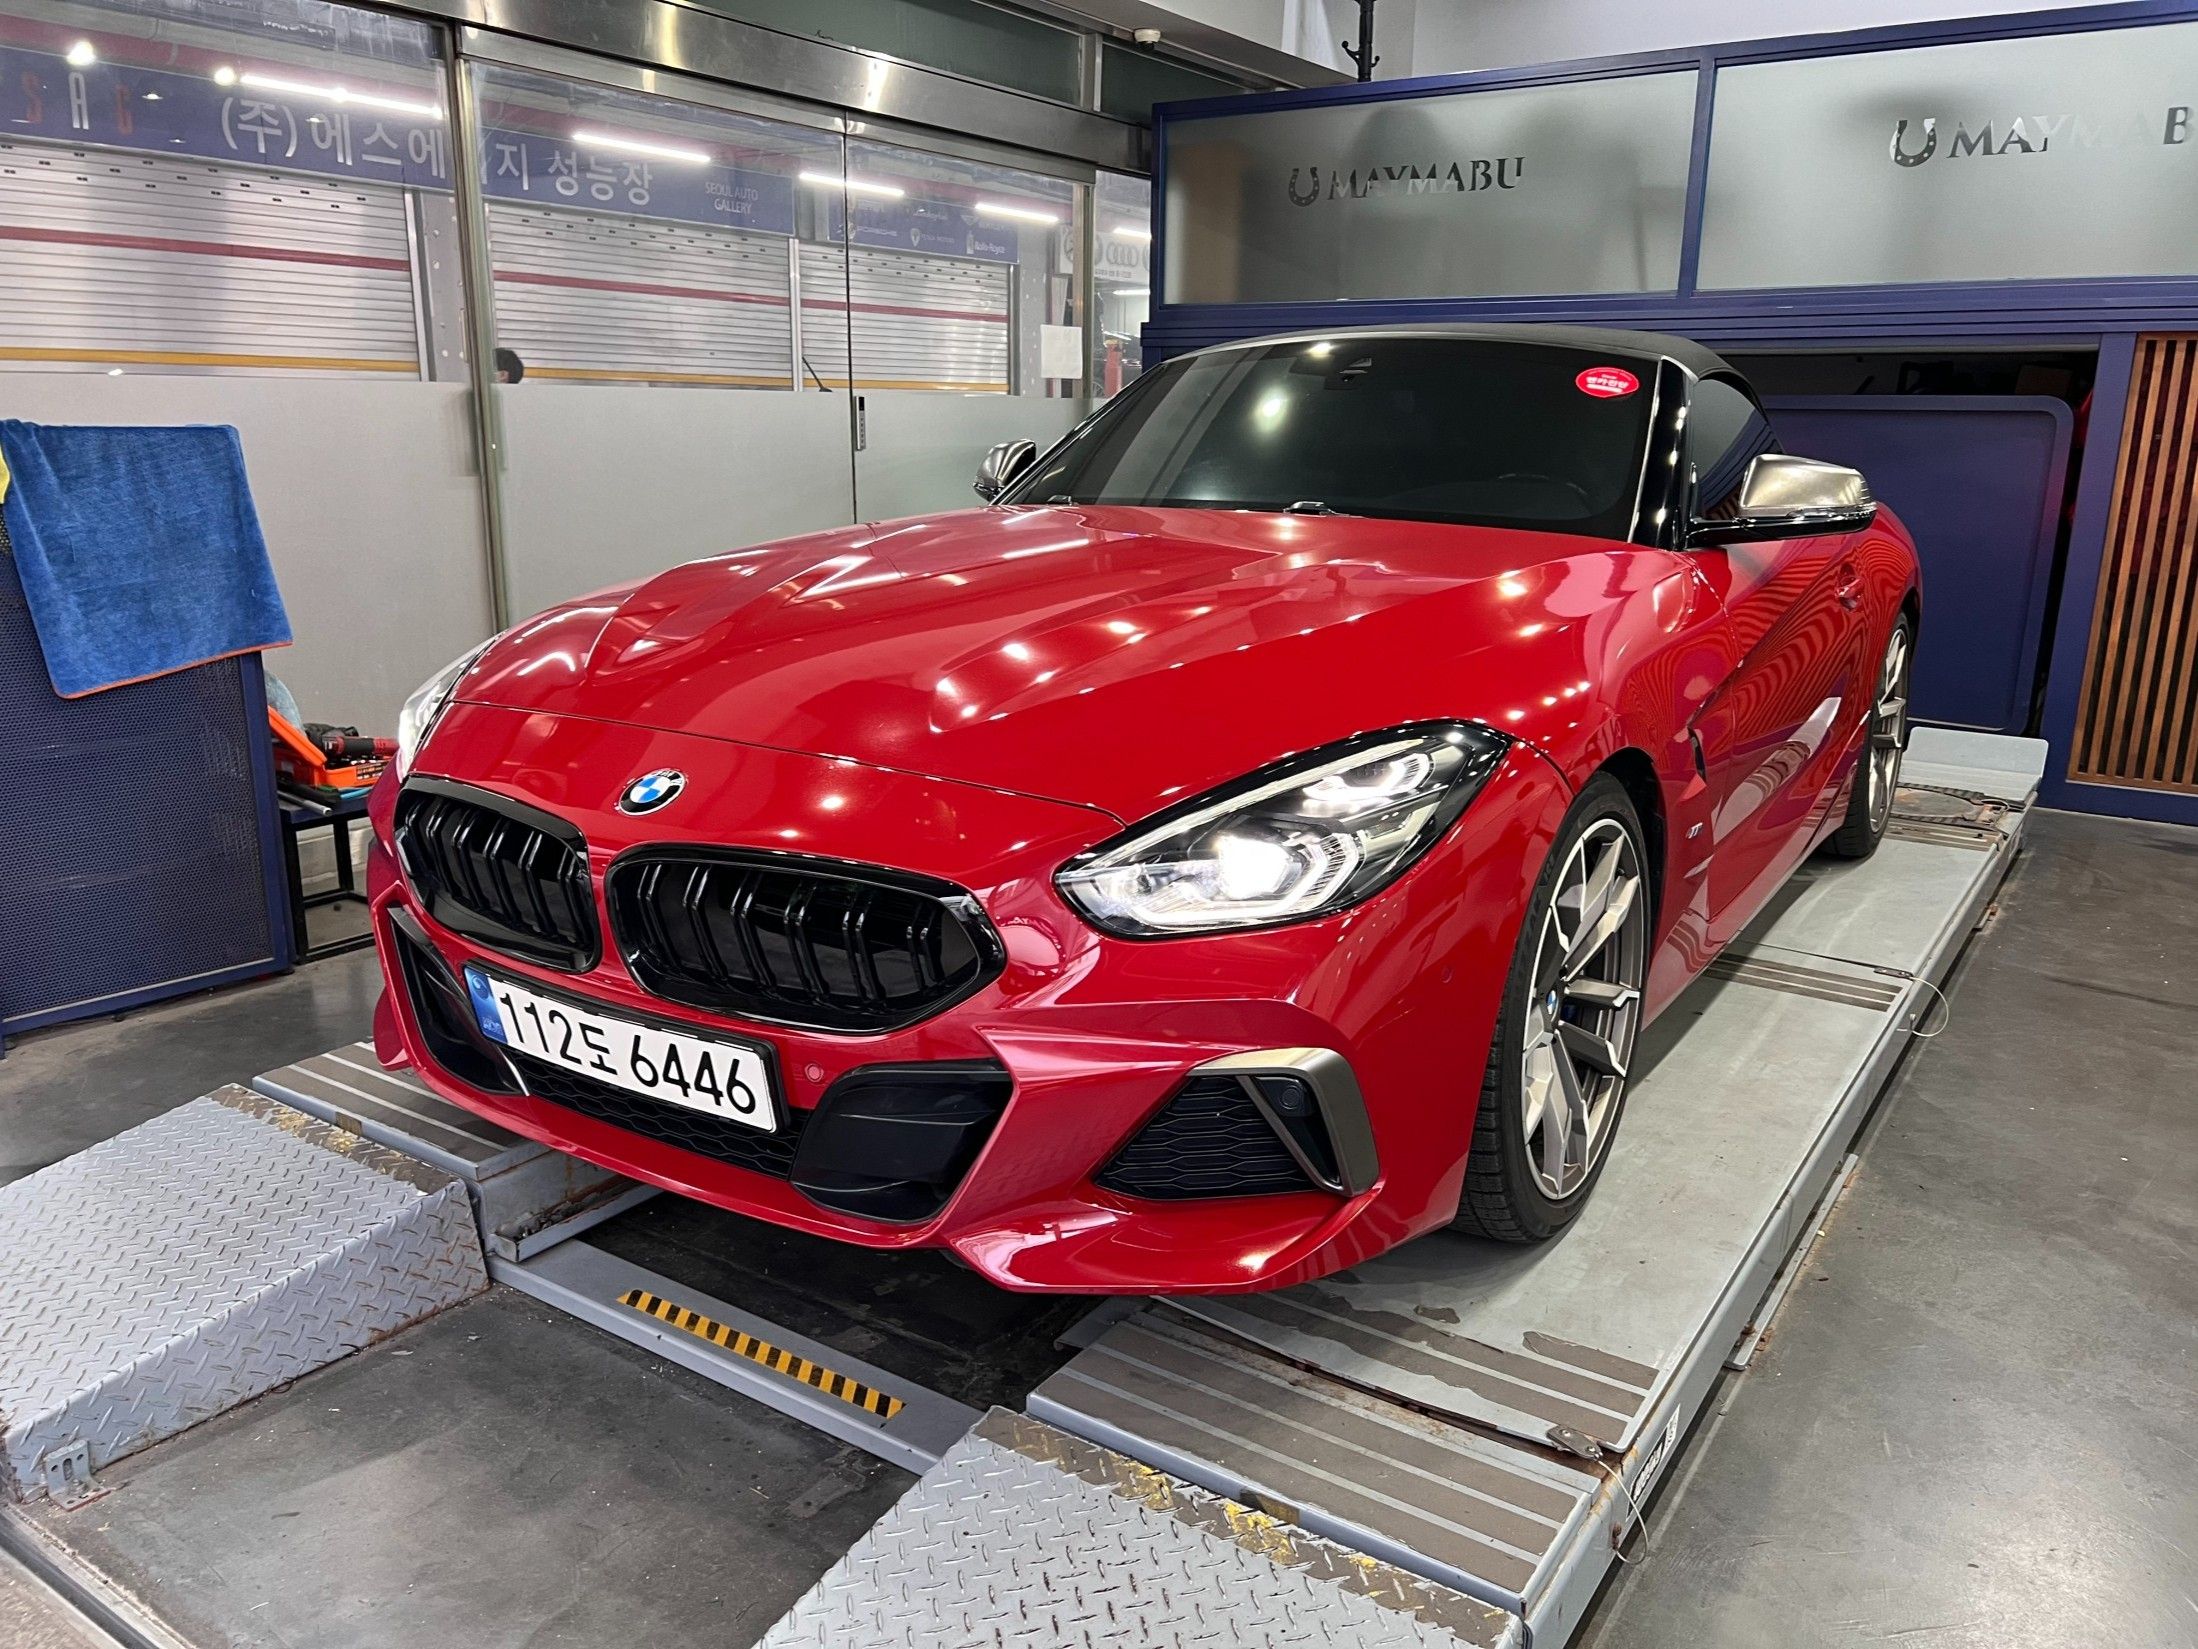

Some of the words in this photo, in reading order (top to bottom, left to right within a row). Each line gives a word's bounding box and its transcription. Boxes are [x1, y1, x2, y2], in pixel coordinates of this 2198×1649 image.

[547, 150, 653, 206] 성능장
[704, 181, 734, 199] SEOUL
[734, 186, 759, 201] AUTO
[1327, 157, 1526, 200] MAYMABU
[714, 198, 752, 215] GALLERY
[500, 992, 618, 1076] 112도
[630, 1034, 757, 1115] 6446
